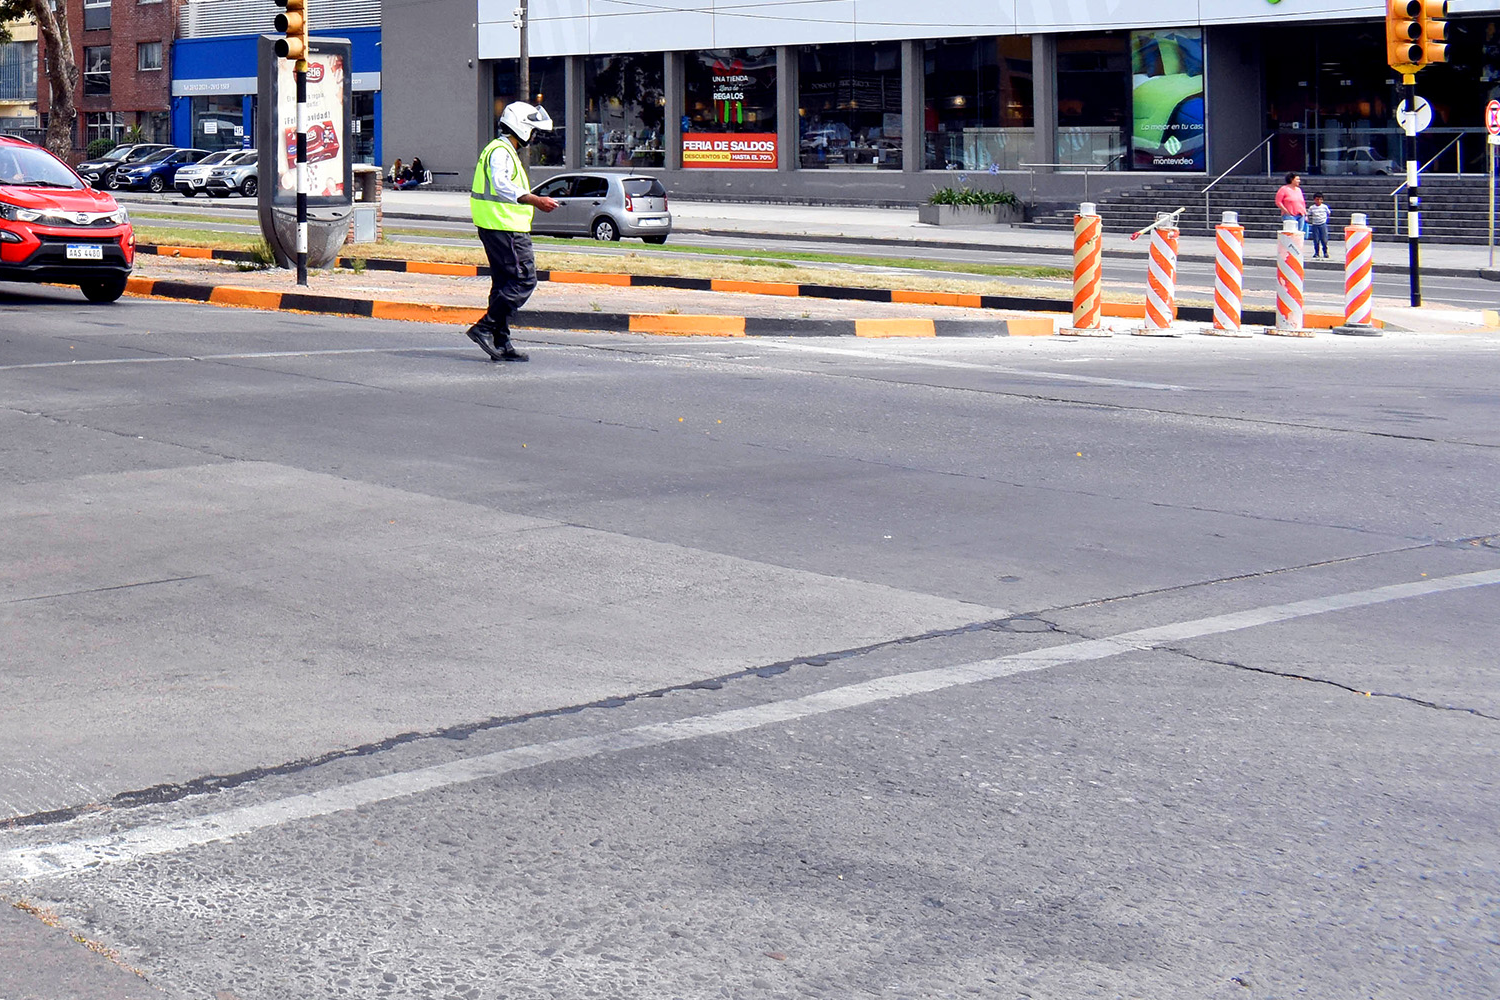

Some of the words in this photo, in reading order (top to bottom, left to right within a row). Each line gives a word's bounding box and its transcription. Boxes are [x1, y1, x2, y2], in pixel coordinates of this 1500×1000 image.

[683, 141, 712, 151] FERIA
[714, 141, 729, 151] DE
[730, 141, 775, 151] SALDOS
[1153, 157, 1194, 165] montevideo
